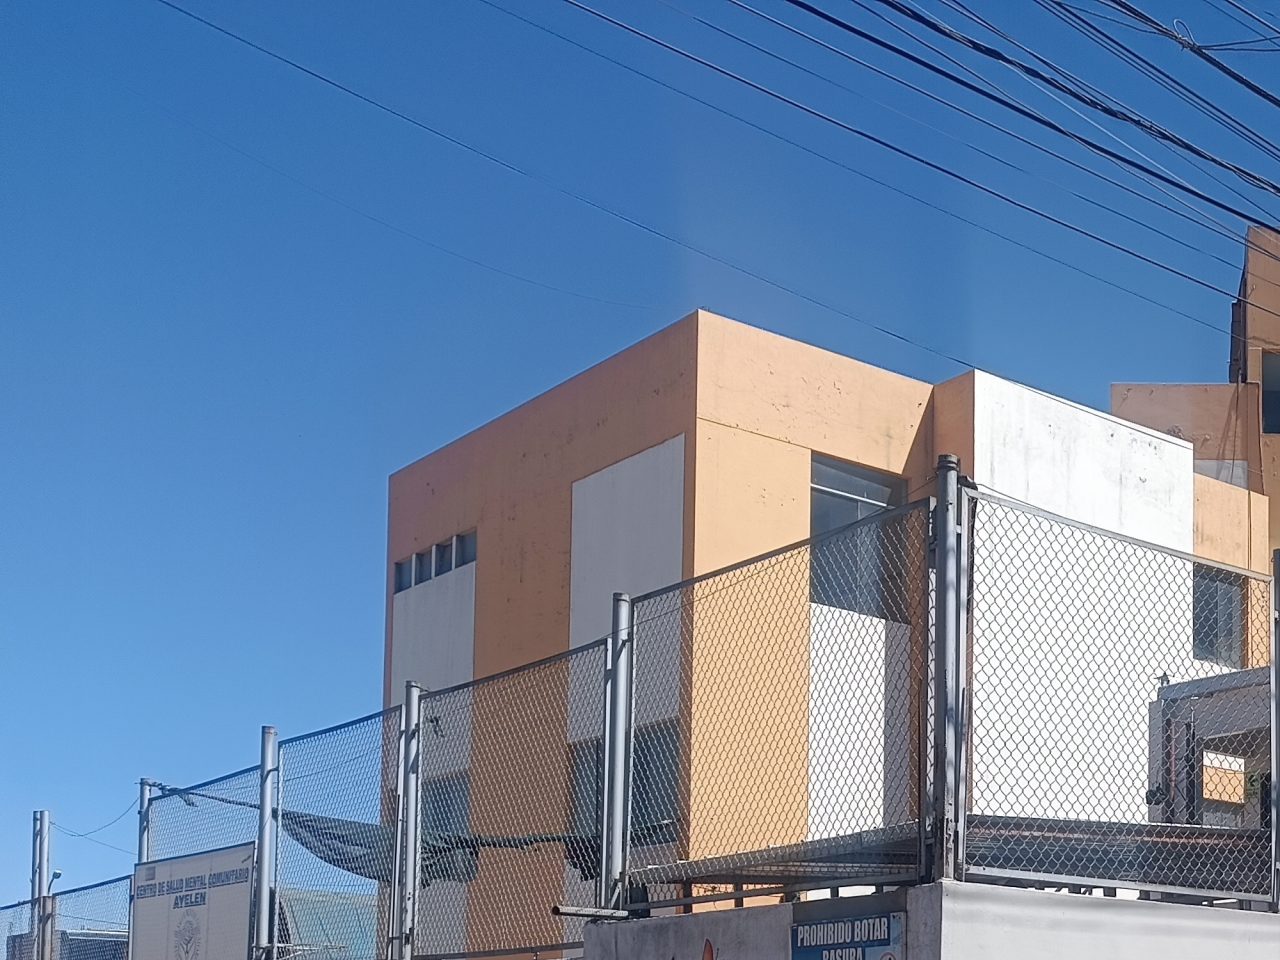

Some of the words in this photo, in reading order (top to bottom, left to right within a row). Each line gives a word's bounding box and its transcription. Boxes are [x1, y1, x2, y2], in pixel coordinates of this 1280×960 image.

[136, 883, 157, 898] CENTRO
[157, 881, 166, 895] DE
[166, 878, 184, 893] SALUD
[185, 874, 208, 890] MENTAL
[208, 867, 249, 887] COMUNITARIO
[173, 892, 206, 909] AYELEN
[797, 922, 851, 947] PROHIBIDO
[853, 917, 888, 941] BOTAR
